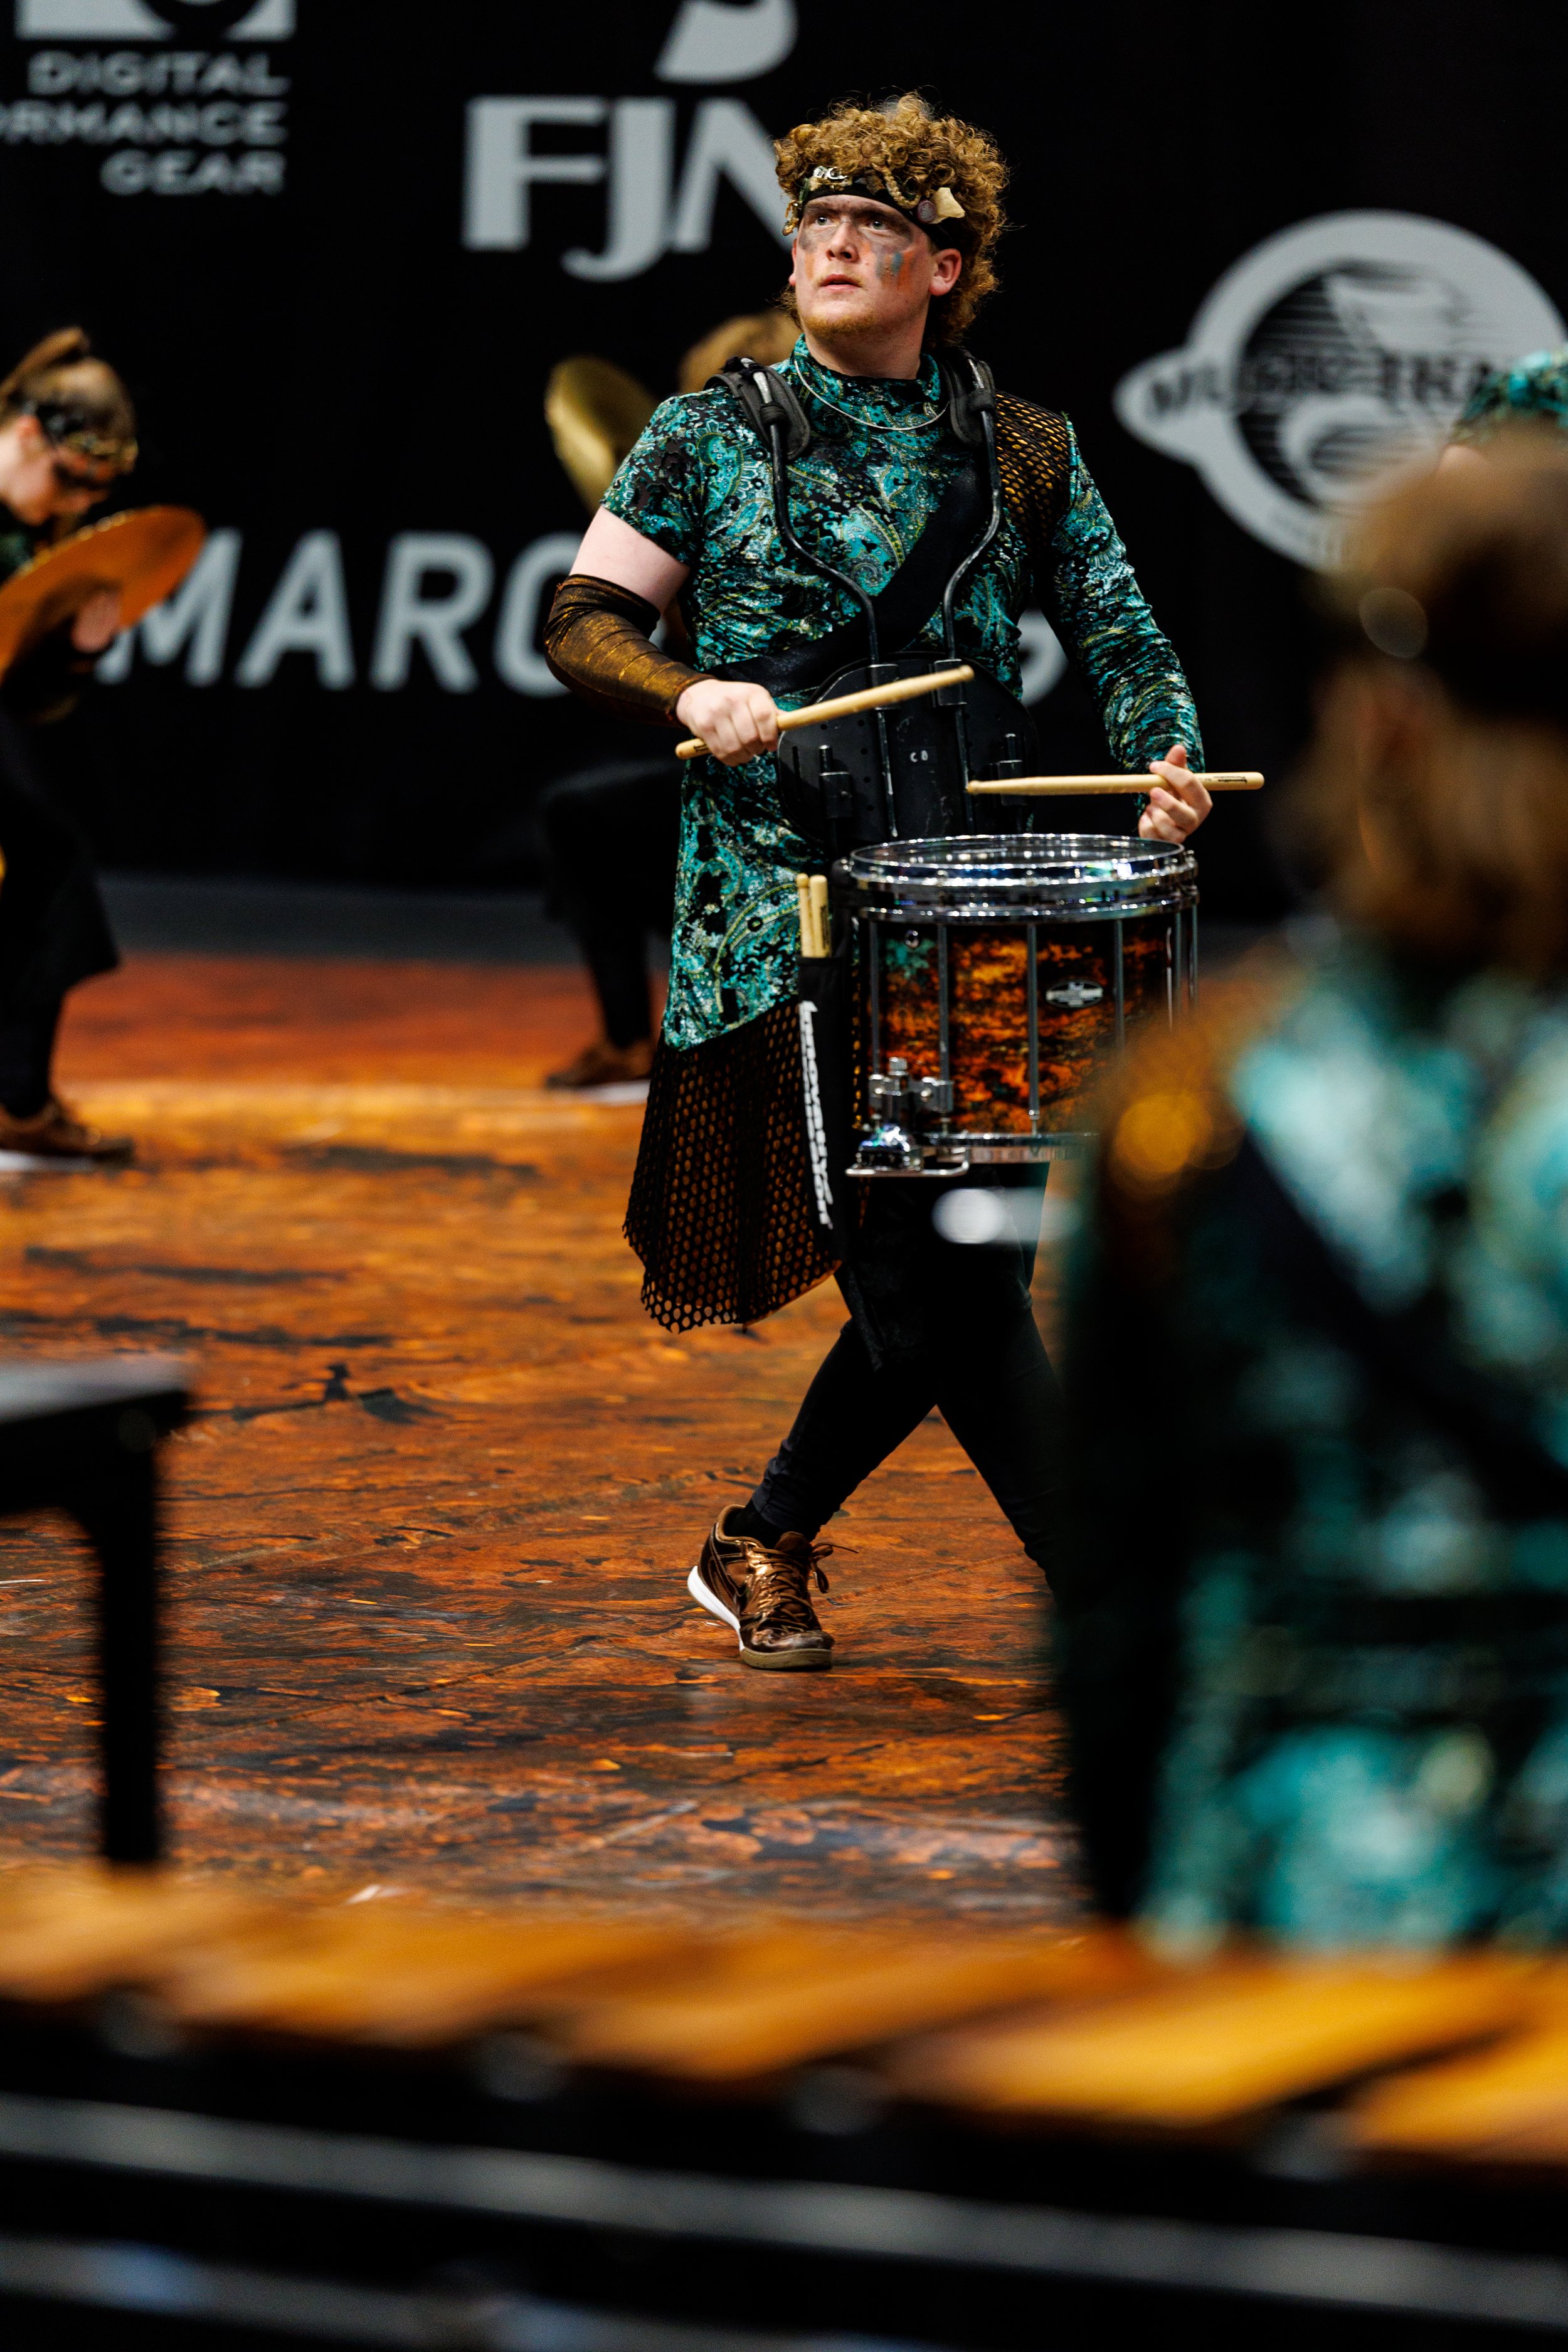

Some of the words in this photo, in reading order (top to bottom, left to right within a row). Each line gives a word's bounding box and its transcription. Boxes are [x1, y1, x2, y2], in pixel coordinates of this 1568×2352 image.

[29, 51, 288, 96] DIGITAL
[0, 100, 285, 145] RMANCE
[101, 150, 284, 194] GEAR
